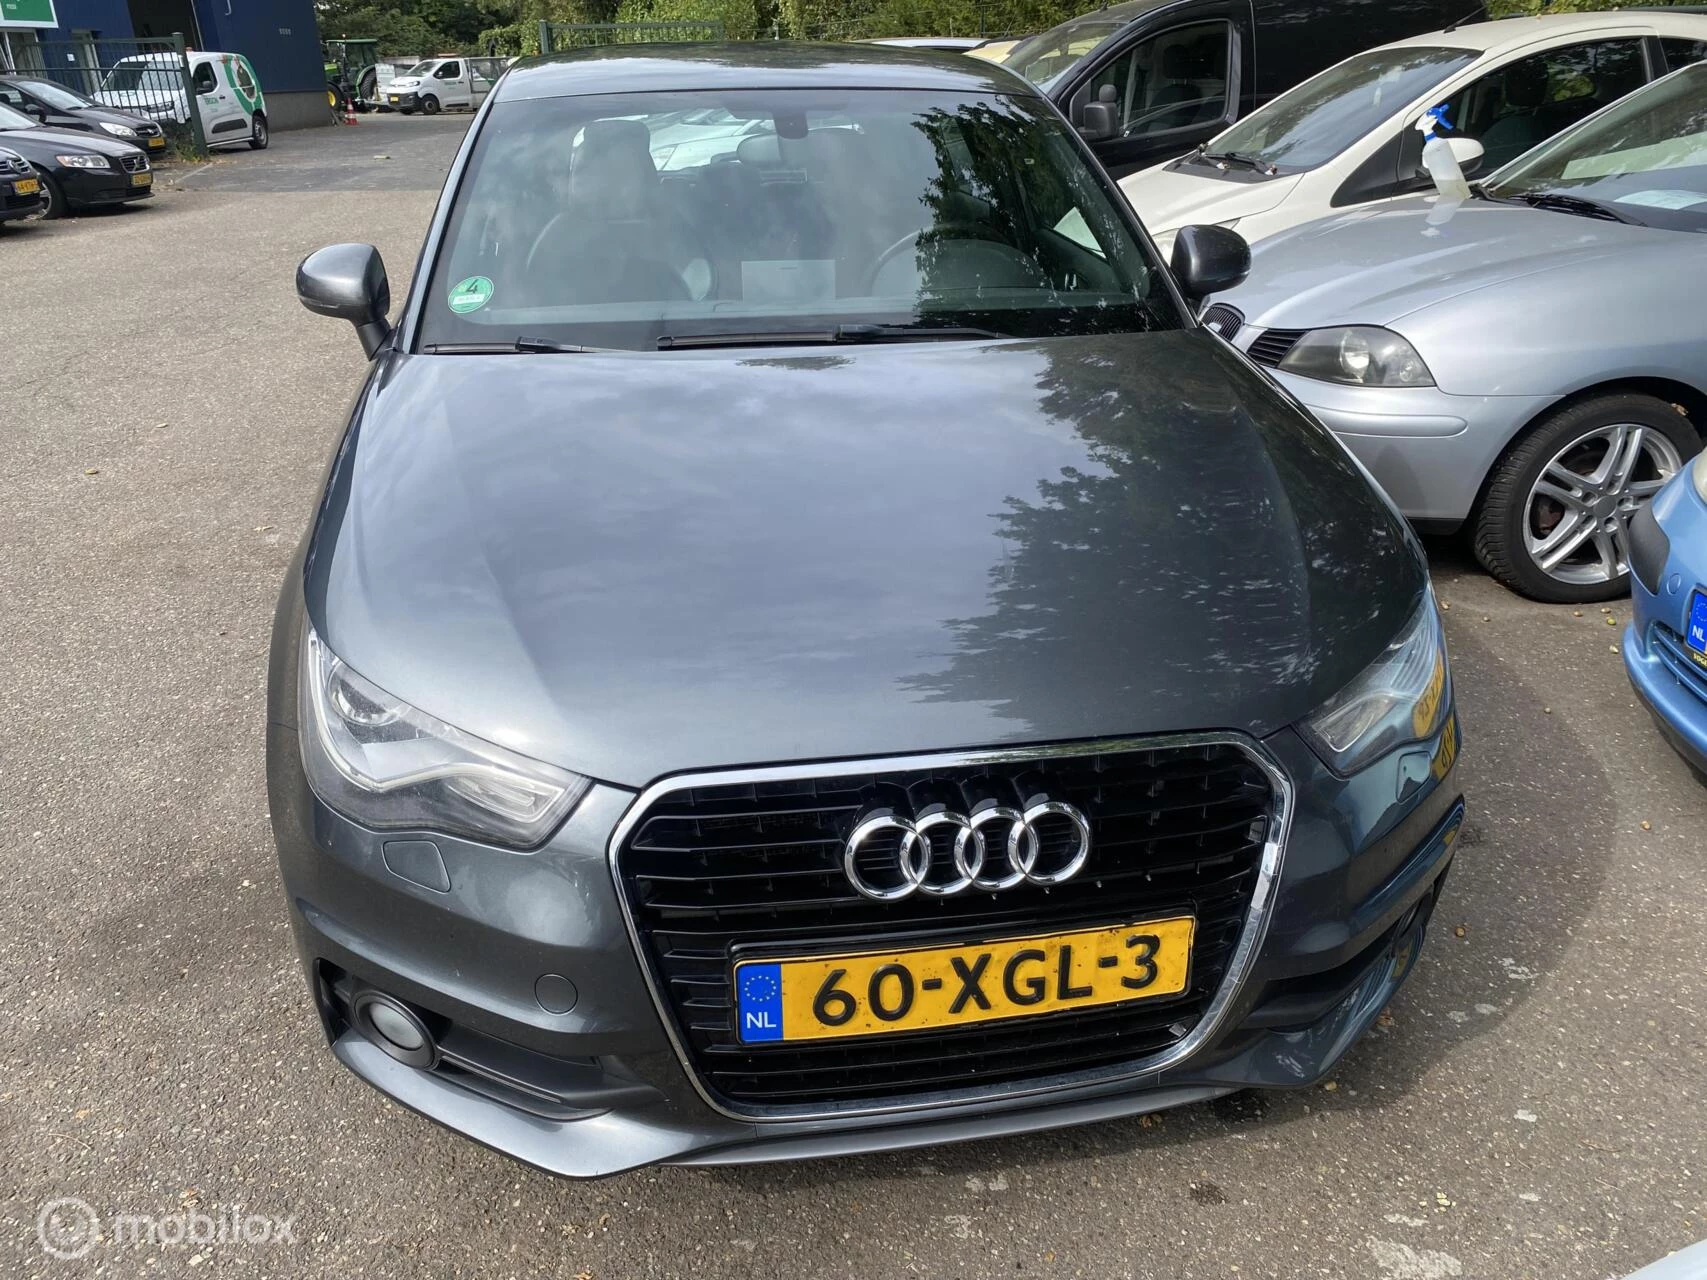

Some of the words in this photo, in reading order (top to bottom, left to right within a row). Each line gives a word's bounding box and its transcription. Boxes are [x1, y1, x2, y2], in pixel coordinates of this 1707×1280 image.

[466, 279, 479, 294] 4
[1691, 625, 1705, 642] NL
[812, 934, 1161, 1027] 60-XGL-3
[746, 1011, 777, 1029] NL
